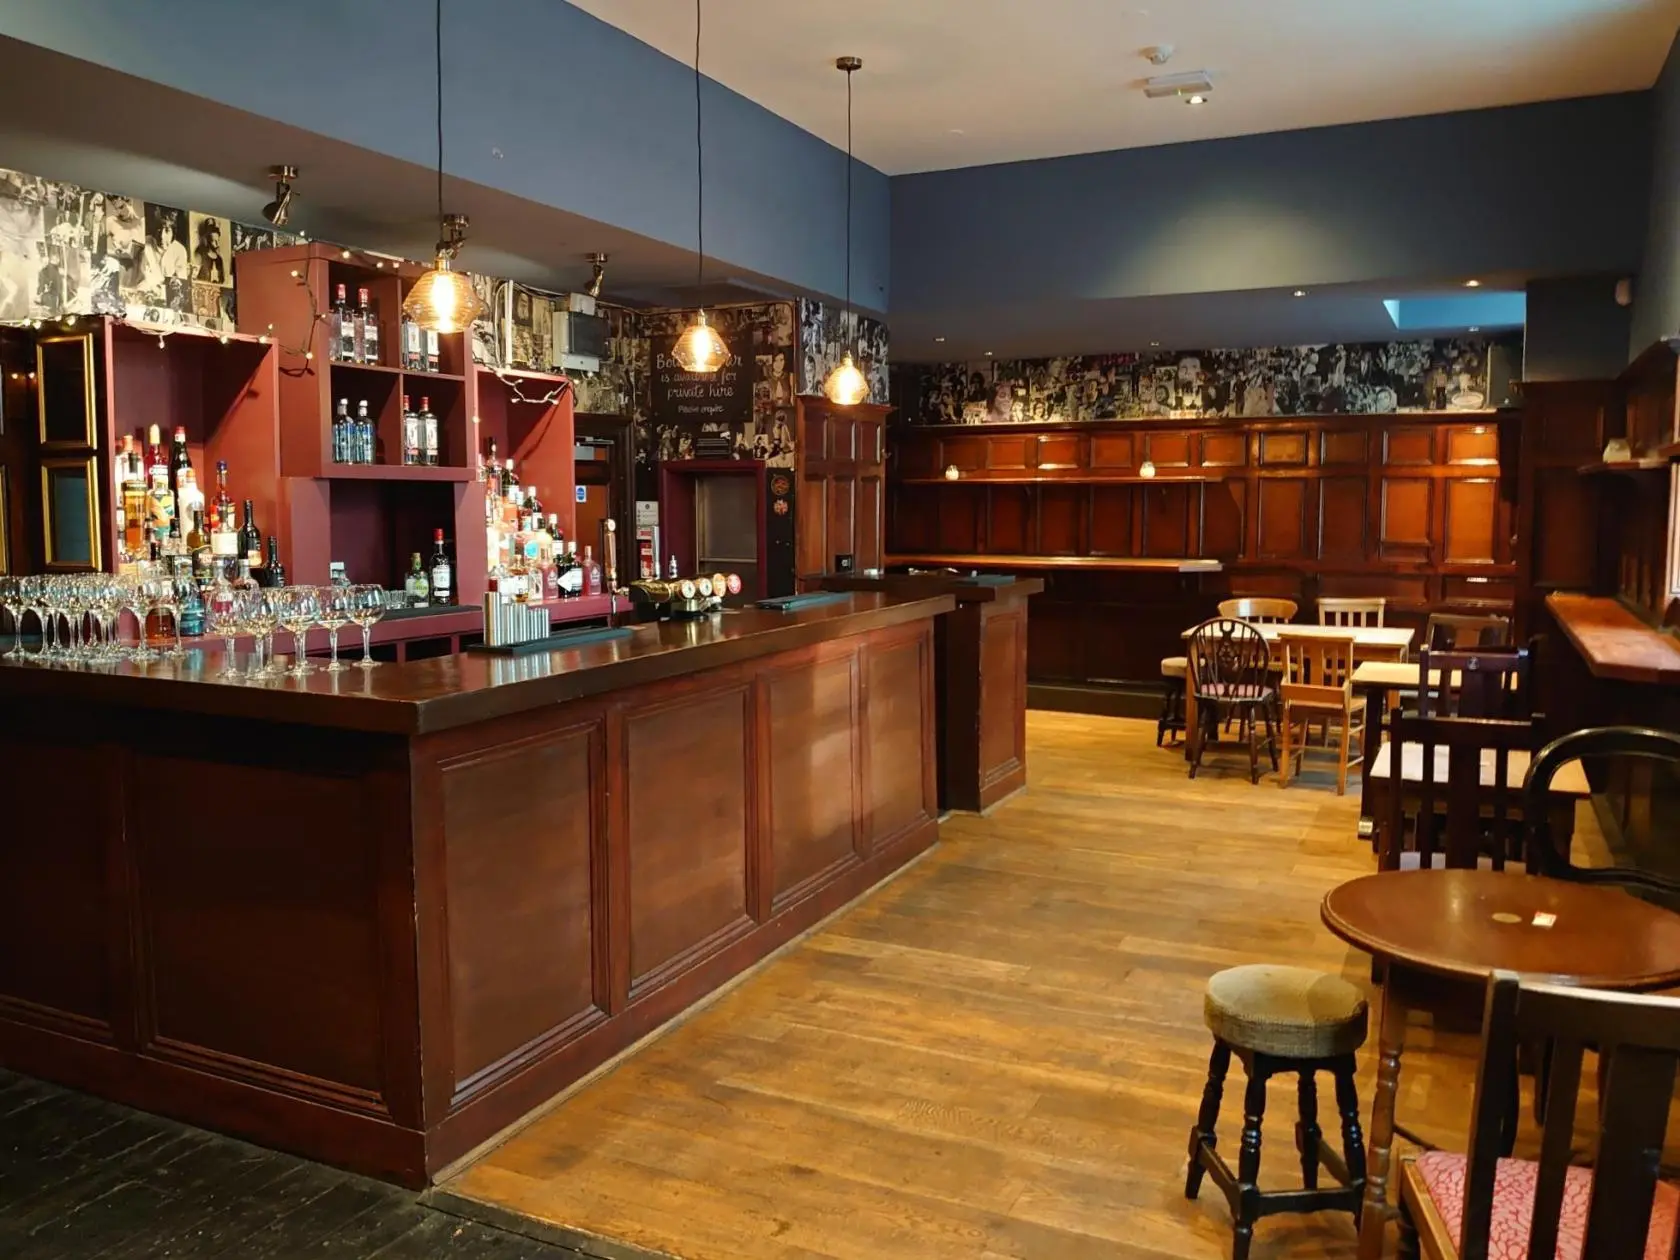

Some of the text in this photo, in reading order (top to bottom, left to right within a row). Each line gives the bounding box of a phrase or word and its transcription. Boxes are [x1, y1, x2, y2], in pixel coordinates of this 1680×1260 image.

[661, 371, 670, 383] is
[721, 368, 737, 385] for
[667, 383, 734, 400] private hire
